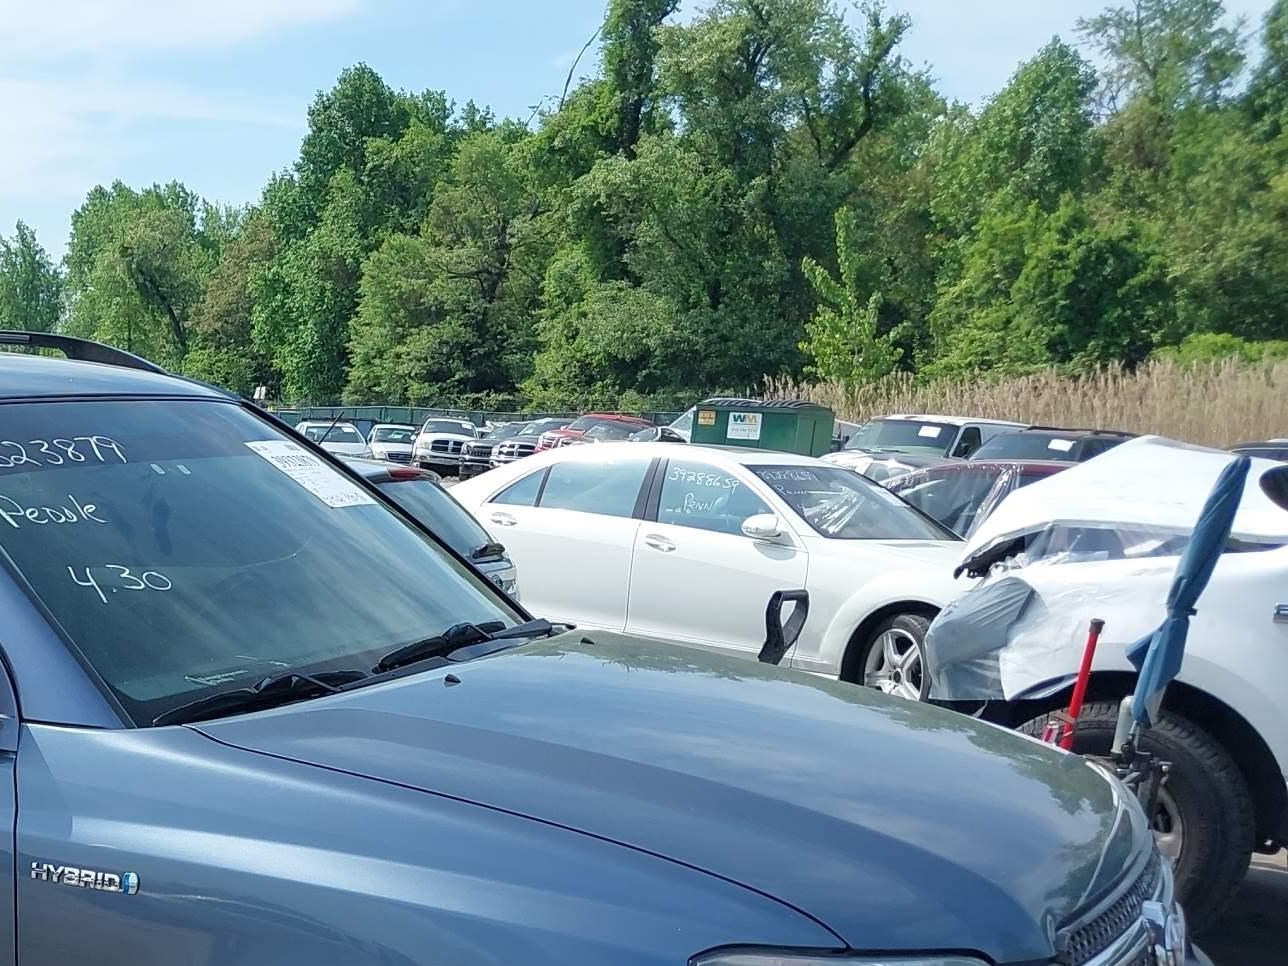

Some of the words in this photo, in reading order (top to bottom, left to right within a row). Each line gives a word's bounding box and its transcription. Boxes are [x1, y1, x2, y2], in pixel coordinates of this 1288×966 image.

[668, 466, 740, 496] 39288659
[67, 564, 173, 604] 4.30
[31, 861, 122, 892] HYBRID
